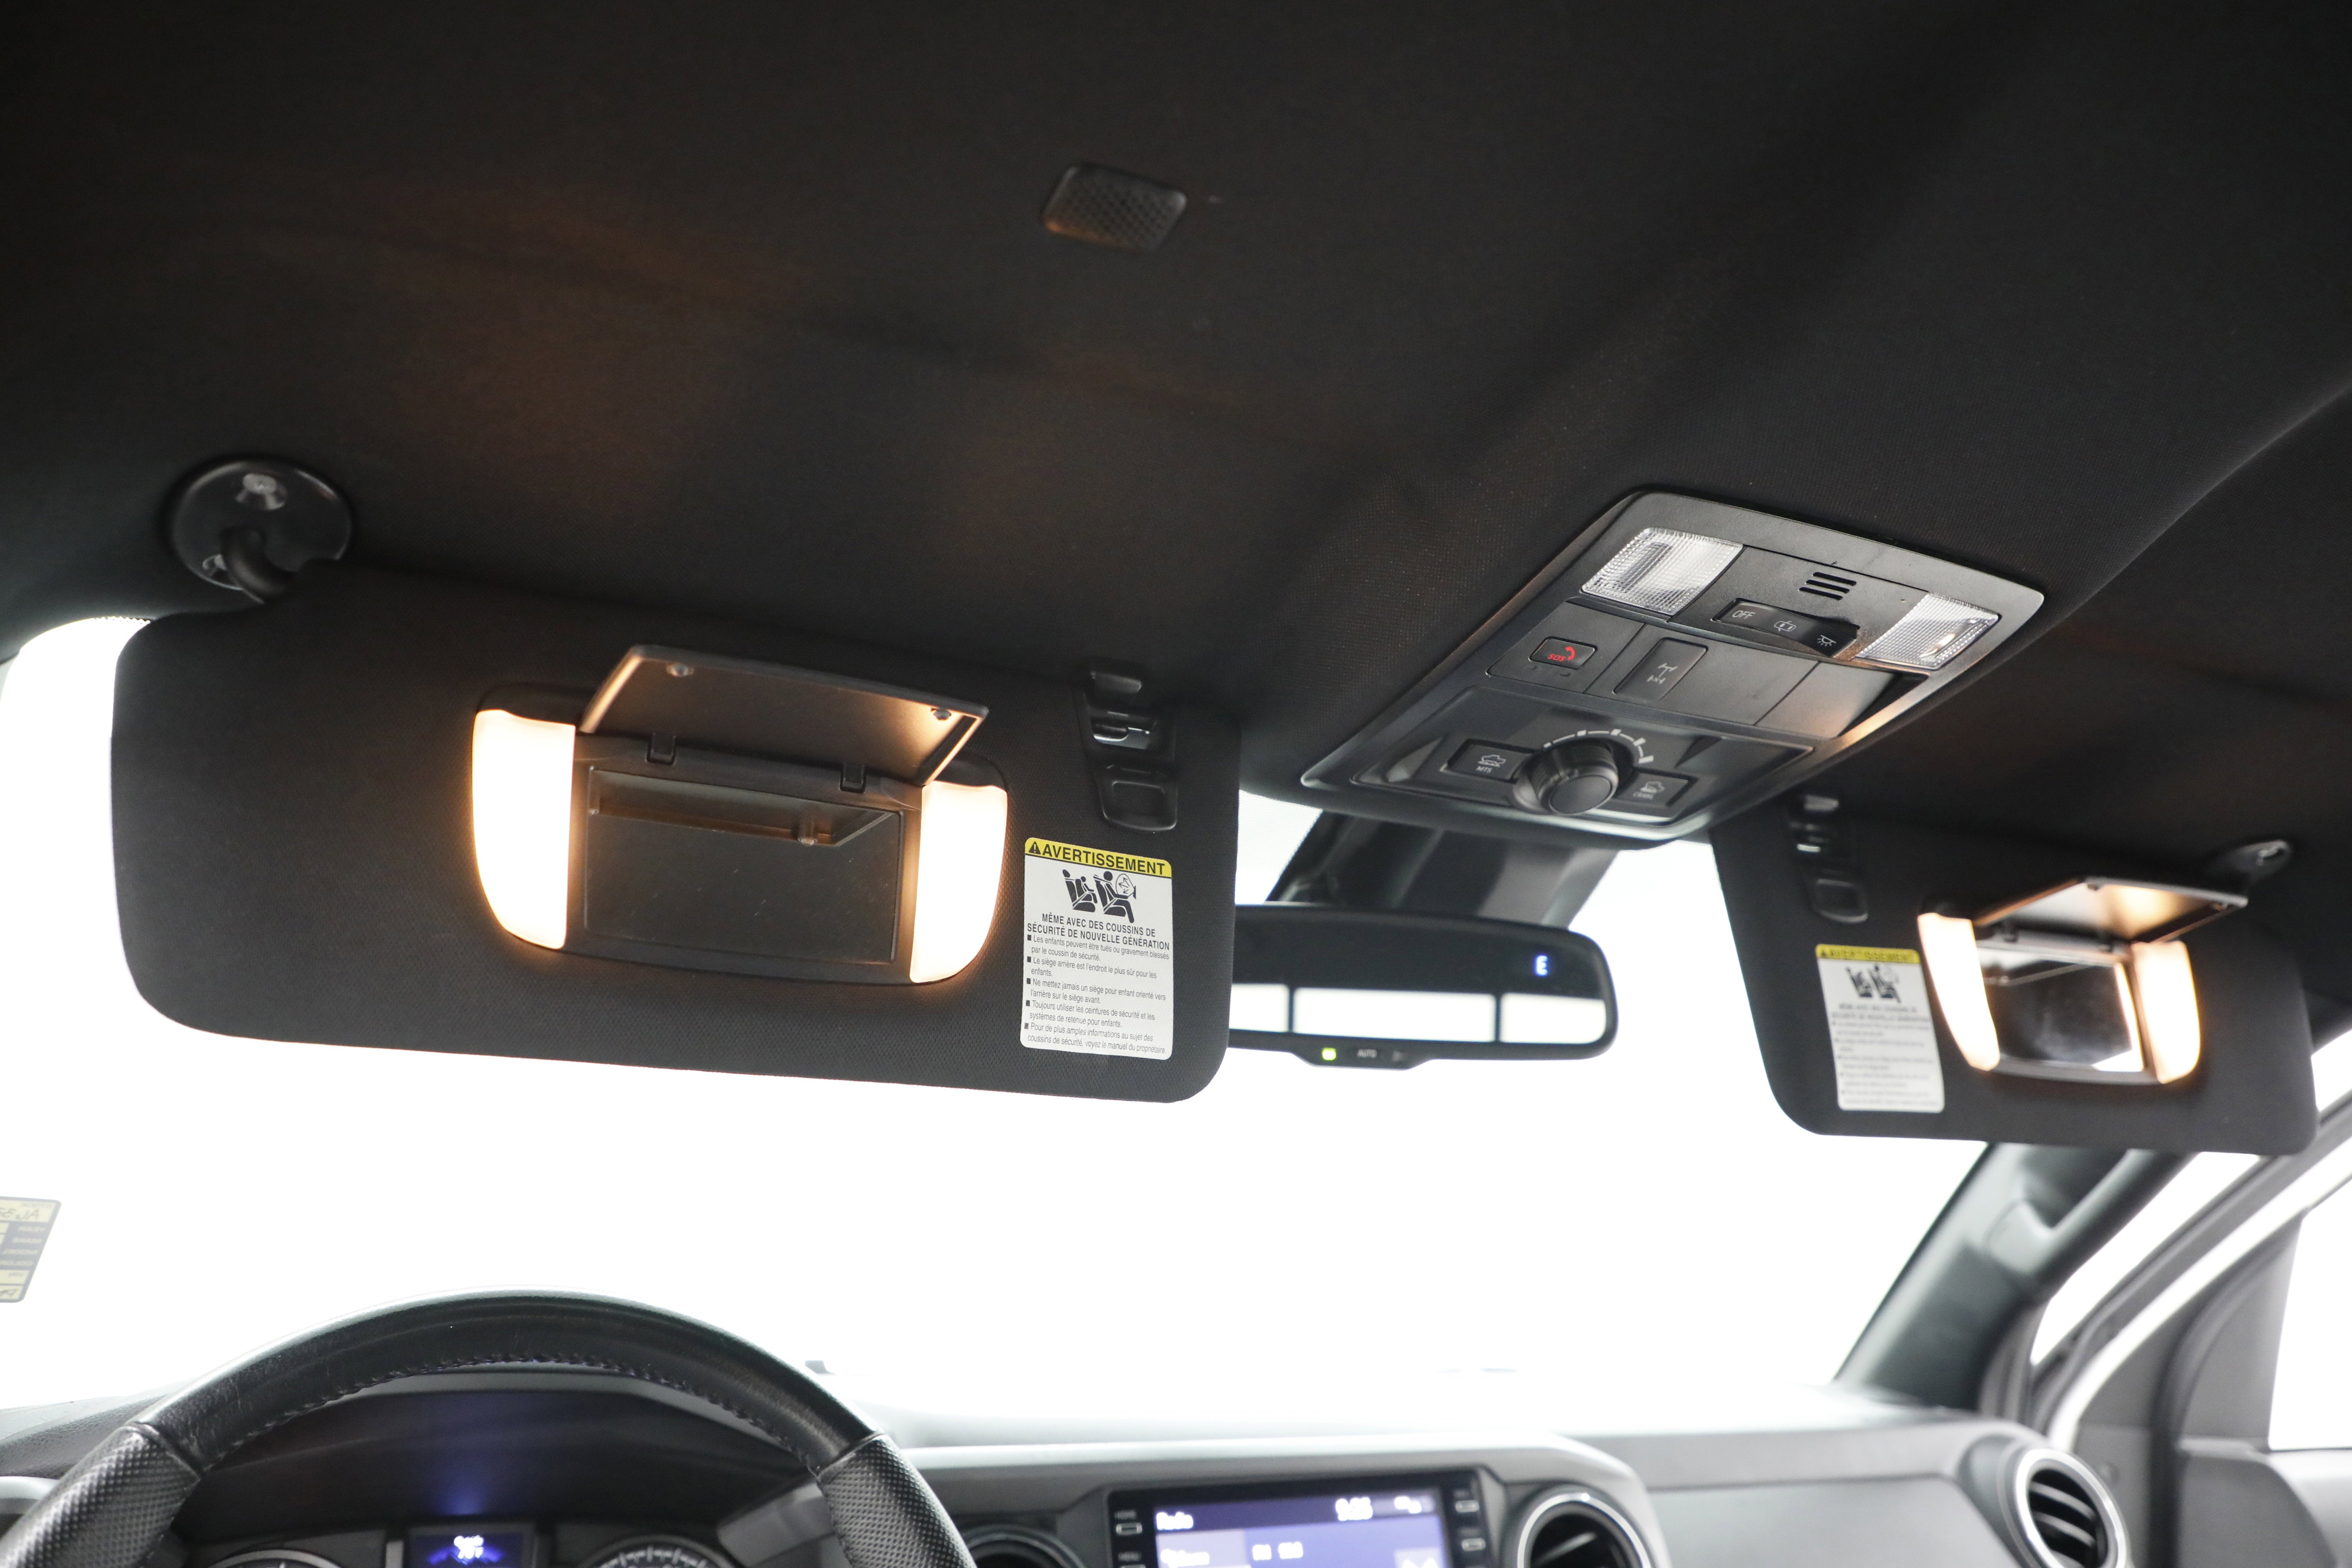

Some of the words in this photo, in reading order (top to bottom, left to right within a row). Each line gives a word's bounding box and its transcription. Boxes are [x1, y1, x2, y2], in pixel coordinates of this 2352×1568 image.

[1732, 610, 1756, 619] OFF
[1547, 653, 1566, 662] SOS
[1042, 844, 1165, 875] AVERTISSEMENT
[1042, 912, 1064, 924] MÊME
[1066, 917, 1086, 928] AVEC
[1089, 920, 1104, 930] DES
[1106, 922, 1144, 935] COUSSINS
[1146, 928, 1156, 938] DE
[1027, 921, 1065, 936] SÉCURITÉ
[1068, 929, 1078, 938] DE
[1080, 930, 1120, 944] NOUVELLE
[1122, 935, 1169, 951] GÉNÉRATION
[1033, 935, 1044, 943] Les
[1045, 937, 1065, 946] enfants
[1066, 941, 1087, 949] peuvent
[1089, 942, 1099, 951] être
[1100, 944, 1112, 952] tués
[1121, 948, 1149, 957] gravement
[1149, 950, 1169, 960] blessés
[1048, 949, 1069, 957] coussin
[1078, 951, 1101, 961] sécurité.
[1031, 967, 1053, 977] enfants.
[1041, 958, 1056, 968] siège
[1058, 960, 1075, 969] arrière
[1086, 963, 1107, 973] l'endroit
[1114, 967, 1125, 975] plus
[1535, 955, 1548, 976] E
[1031, 989, 1051, 998] l'arrière
[1062, 992, 1068, 1000] le
[1069, 993, 1084, 1003] siège
[1033, 978, 1041, 986] Ne
[1042, 980, 1061, 989] mettez
[1061, 981, 1080, 991] jamais
[1089, 985, 1104, 995] siège
[1118, 989, 1135, 997] enfant
[1136, 991, 1154, 999] orienté
[1032, 1000, 1056, 1010] Toujours
[1057, 1003, 1075, 1012] utiliser
[1085, 1007, 1109, 1016] ceintures
[1119, 1010, 1140, 1019] sécurité
[1147, 1012, 1155, 1020] les
[1029, 1012, 1056, 1021] systèmes
[1057, 1014, 1064, 1022] de
[1065, 1016, 1086, 1025] retenue
[1101, 1019, 1122, 1028] enfants.
[1031, 1022, 1044, 1031] Pour
[1045, 1024, 1052, 1032] de
[1053, 1025, 1065, 1034] plus
[1067, 1027, 1087, 1036] amples
[1087, 1028, 1120, 1038] informations
[1129, 1033, 1143, 1042] sujet
[1143, 1033, 1153, 1042] des
[1027, 1035, 1051, 1043] coussins
[1052, 1036, 1060, 1044] de
[1061, 1037, 1084, 1047] sécurité,
[1085, 1041, 1101, 1049] voyez
[1102, 1040, 1107, 1049] le
[1357, 1049, 1377, 1058] AUTO
